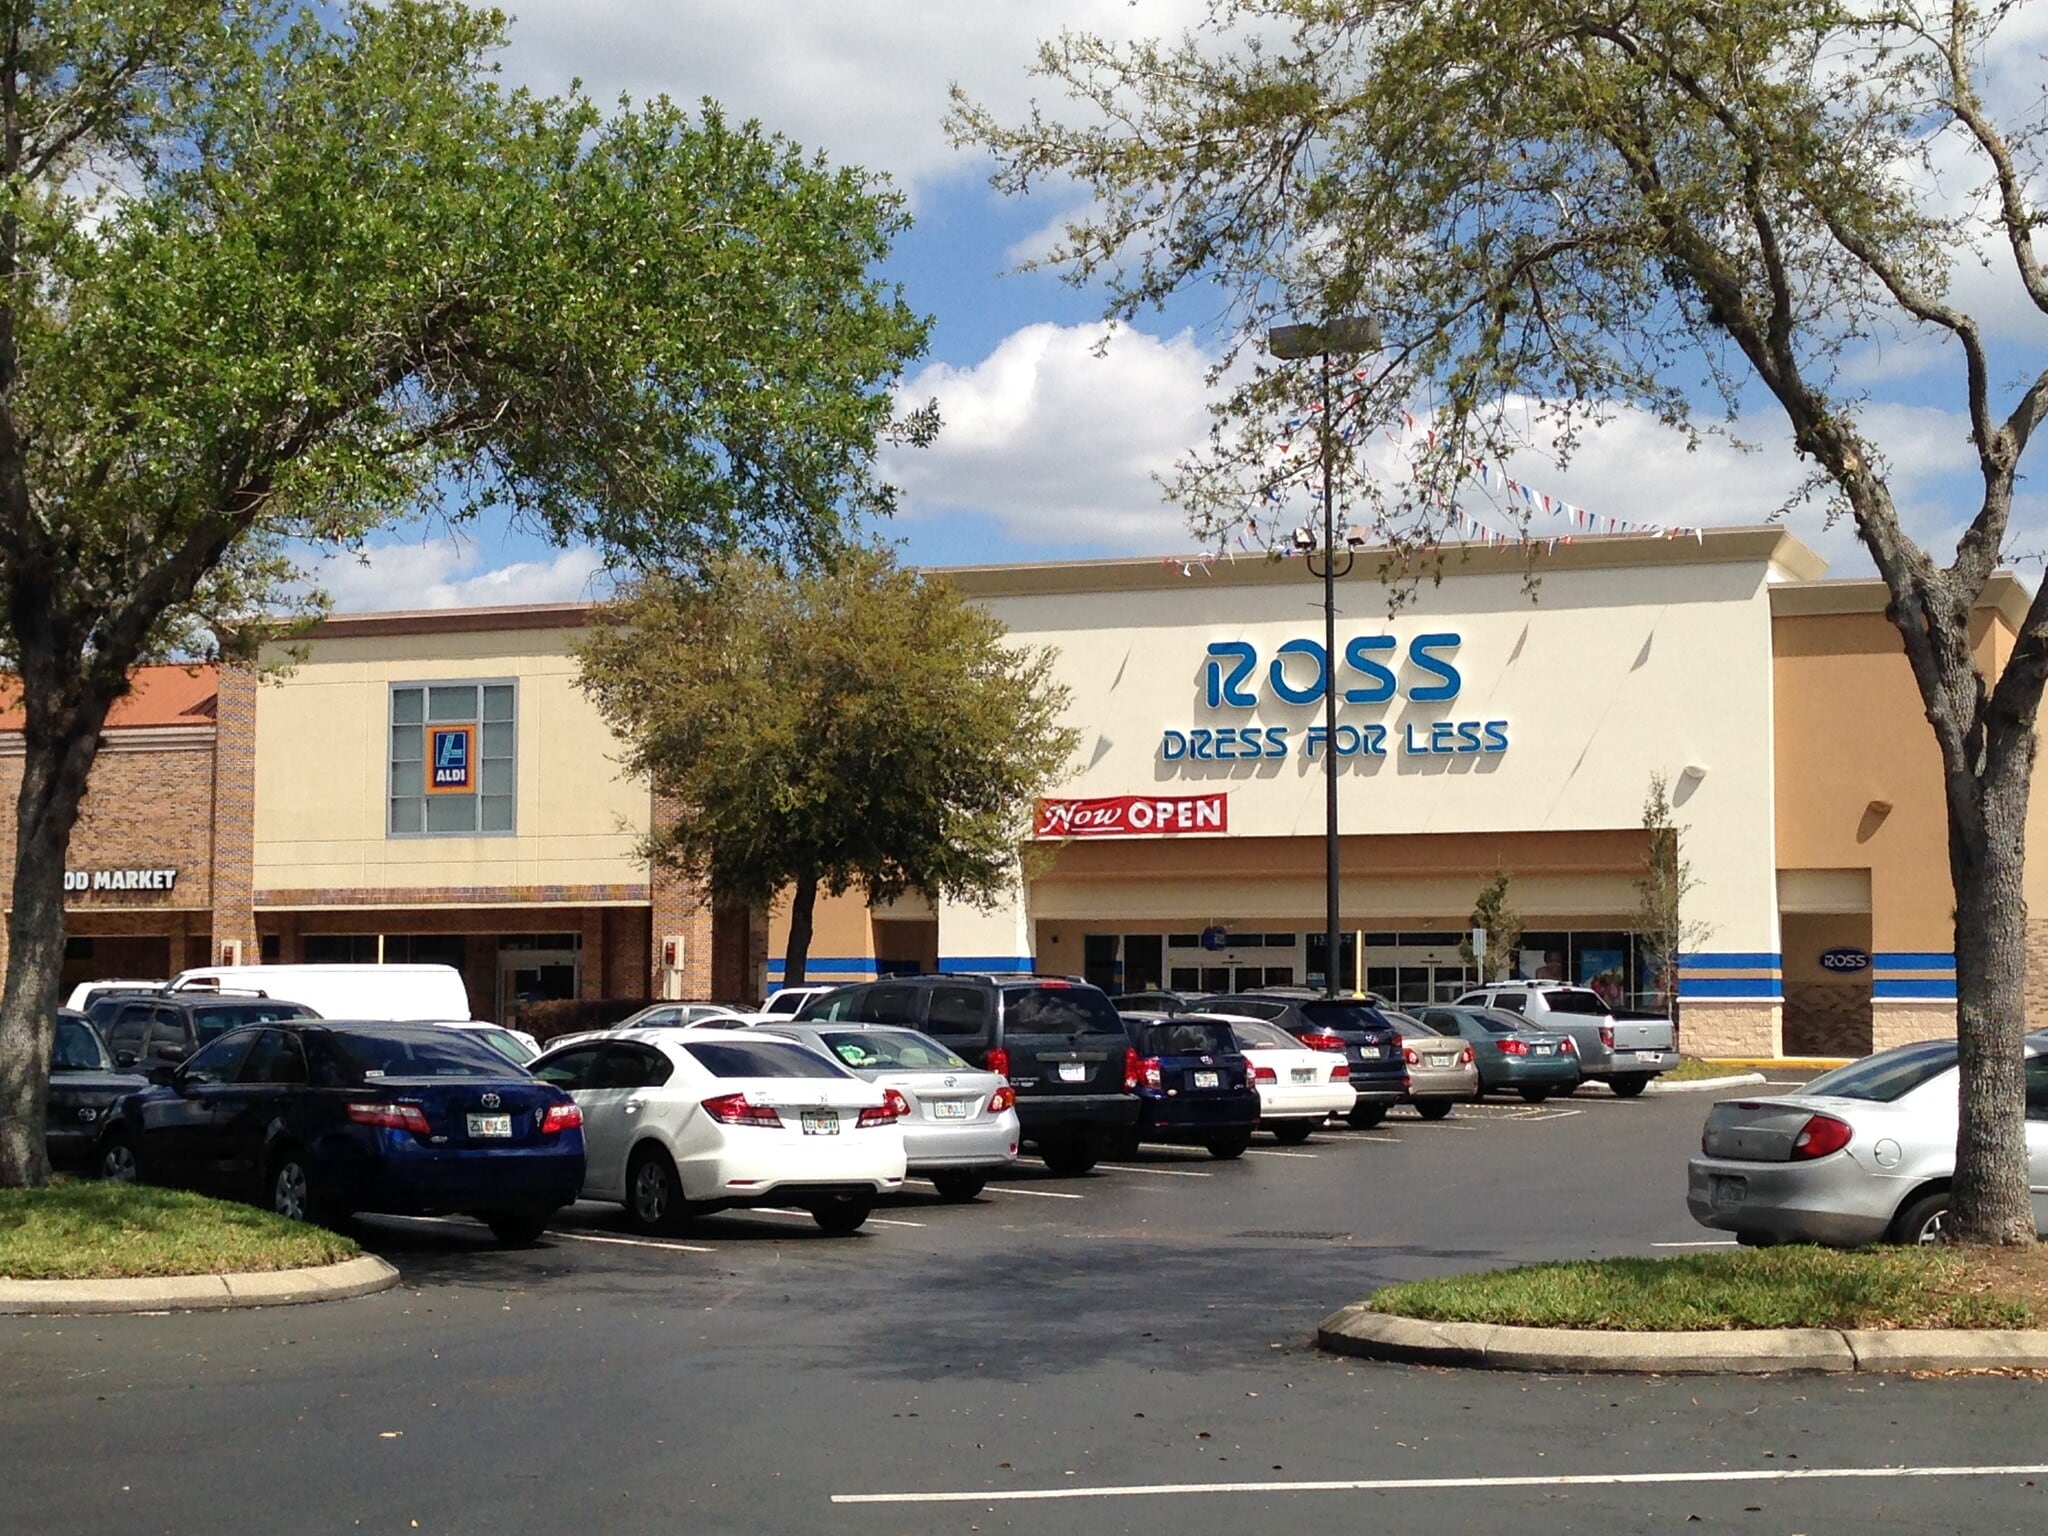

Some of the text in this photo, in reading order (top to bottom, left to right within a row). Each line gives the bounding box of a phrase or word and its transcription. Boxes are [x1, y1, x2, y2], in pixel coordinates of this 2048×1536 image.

[1206, 633, 1463, 708] ROSS
[1163, 719, 1510, 760] DRESS FOR LESS
[436, 769, 466, 782] ALDI
[1039, 799, 1221, 832] Now OPEN
[92, 869, 176, 890] MARKET
[1824, 954, 1867, 967] ROSS
